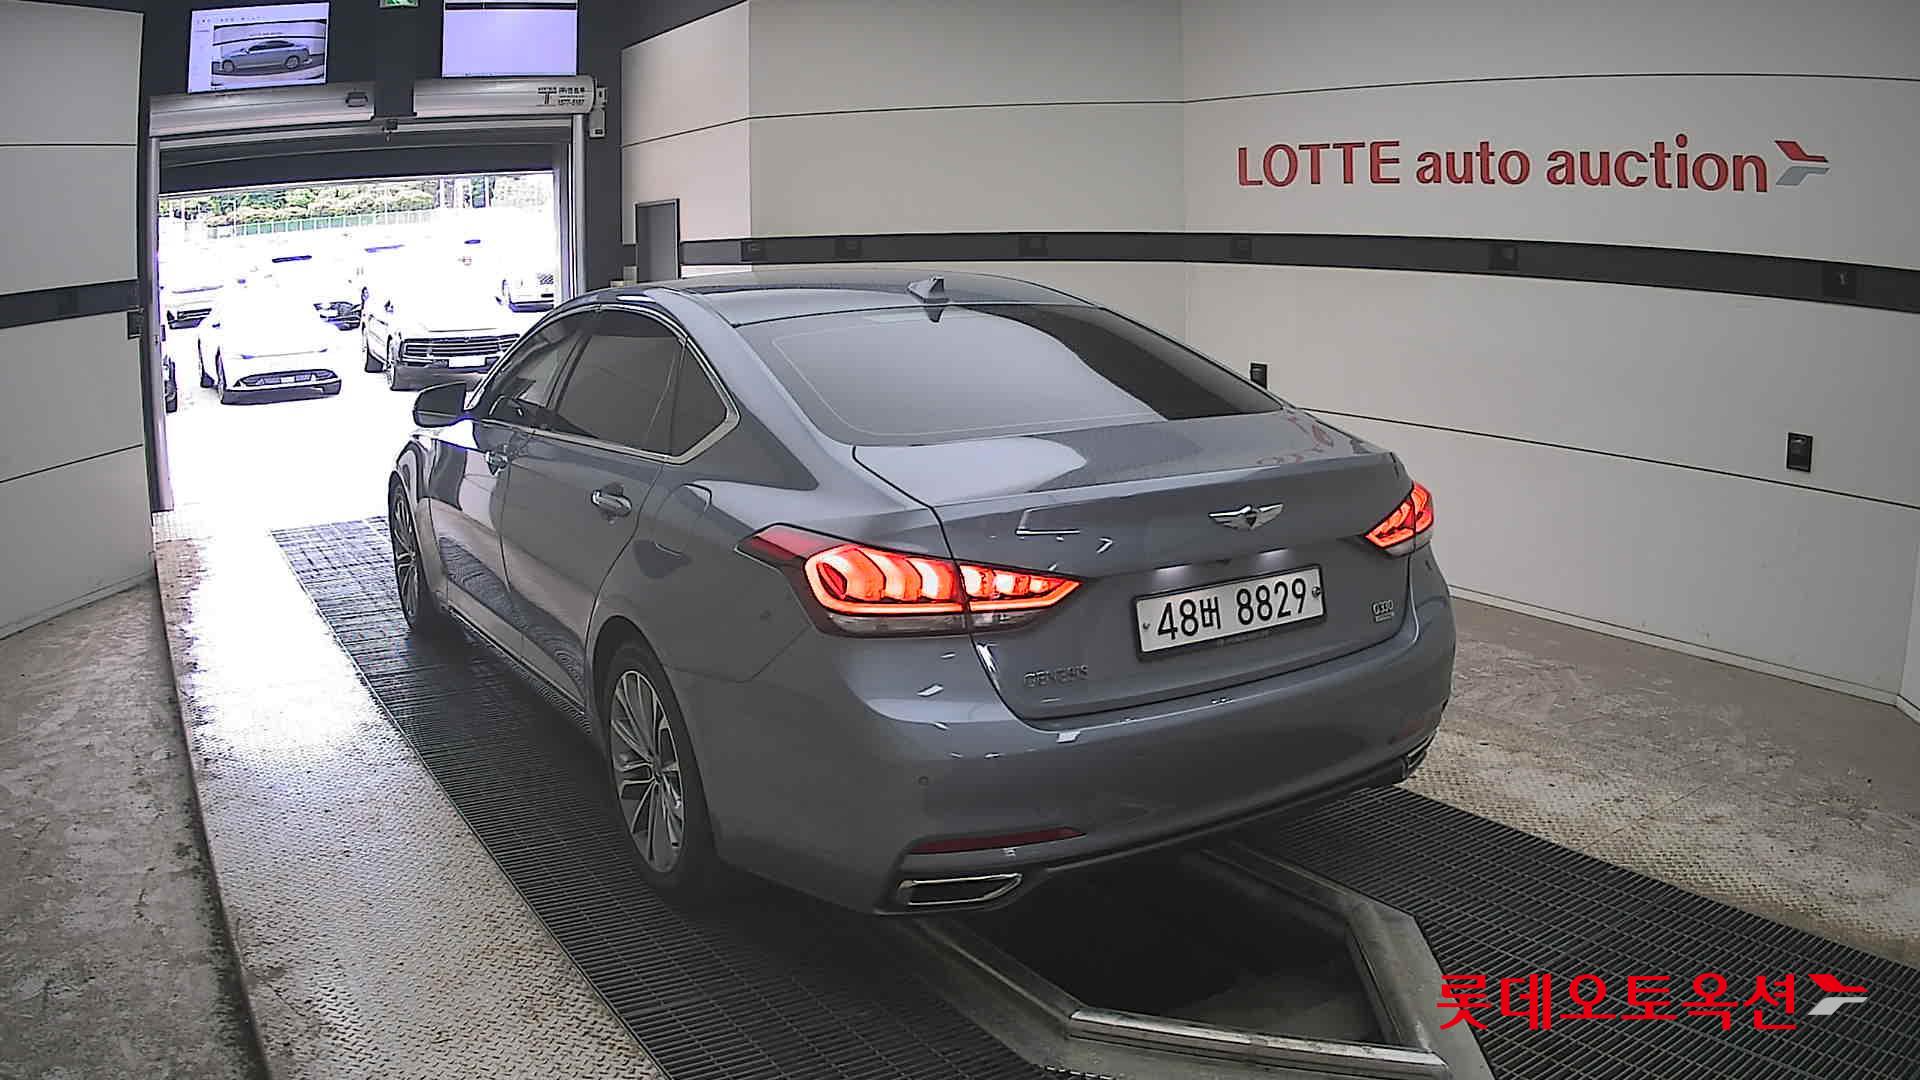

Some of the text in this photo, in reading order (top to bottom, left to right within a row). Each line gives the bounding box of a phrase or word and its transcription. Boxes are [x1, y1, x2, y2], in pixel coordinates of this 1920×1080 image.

[1238, 134, 1768, 193] LOTTE auto auction
[1157, 577, 1307, 641] 48버 8829
